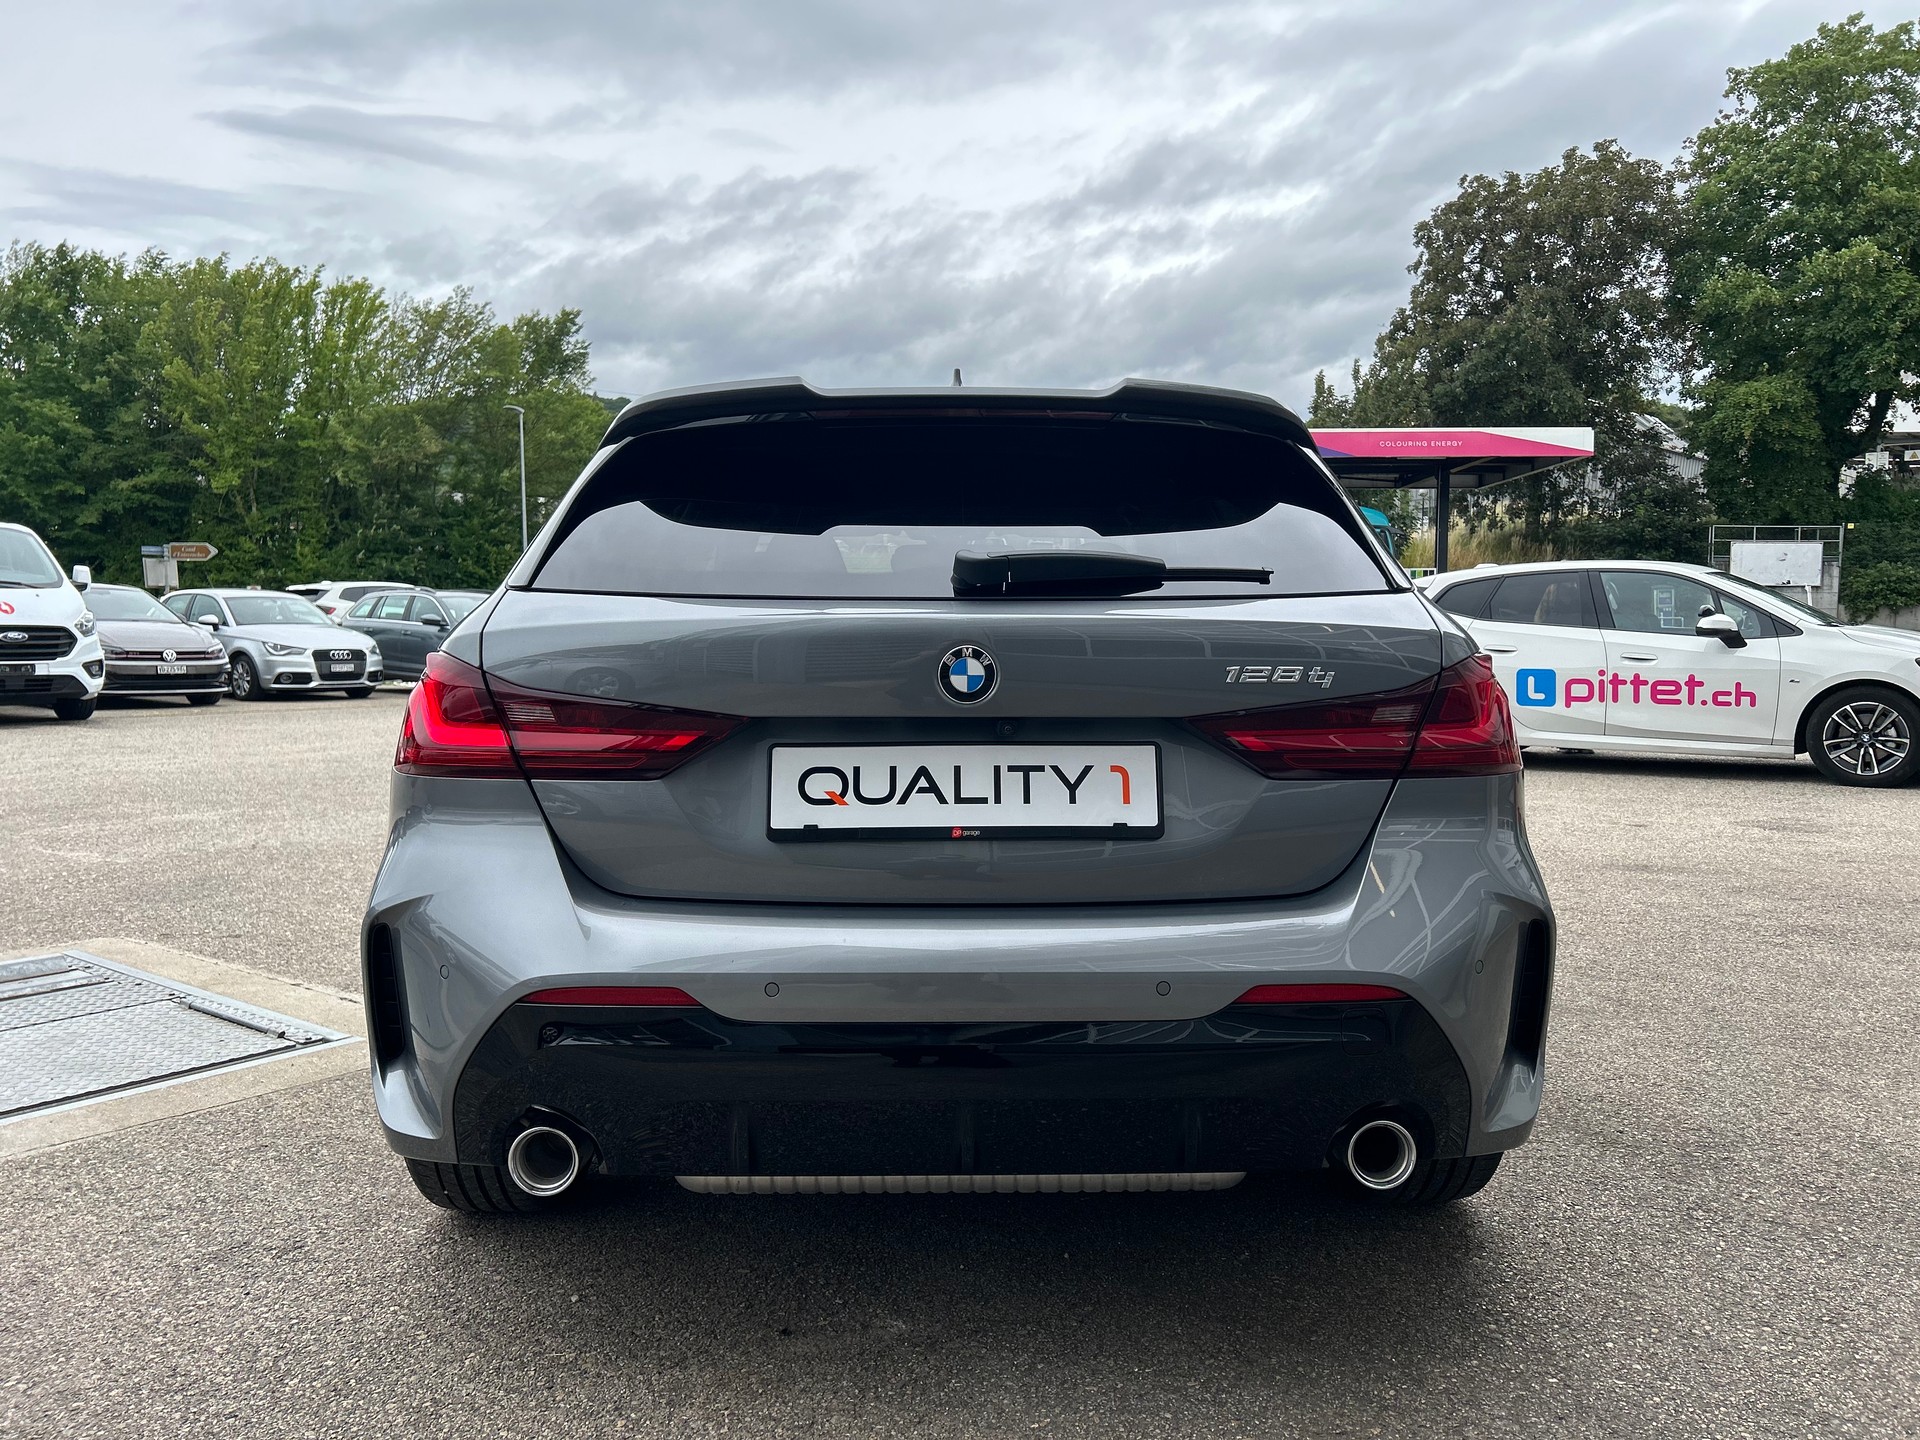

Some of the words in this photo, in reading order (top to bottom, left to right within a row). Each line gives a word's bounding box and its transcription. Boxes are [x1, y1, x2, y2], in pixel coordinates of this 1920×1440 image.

[943, 647, 992, 667] BMW
[1225, 665, 1304, 684] 128
[1564, 668, 1757, 709] pittet.ch
[797, 764, 1095, 806] QUALITY
[1109, 764, 1131, 805] 1
